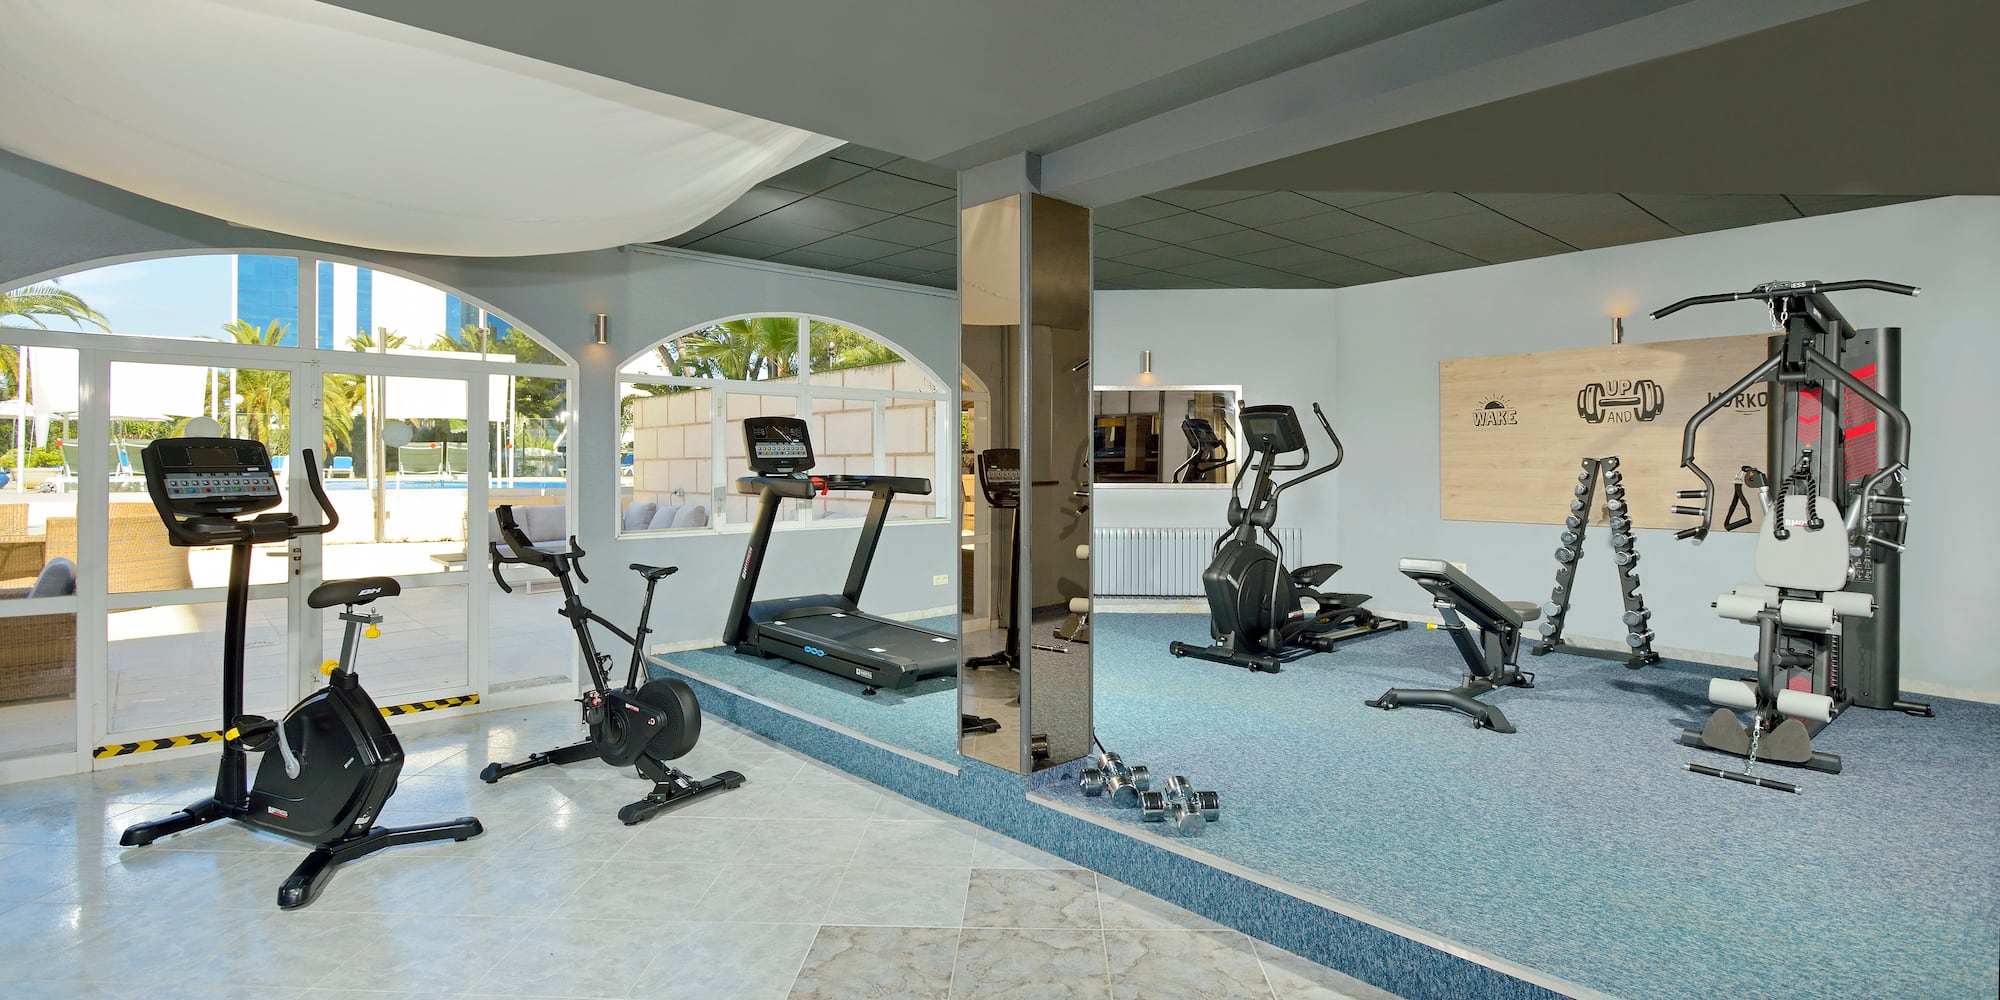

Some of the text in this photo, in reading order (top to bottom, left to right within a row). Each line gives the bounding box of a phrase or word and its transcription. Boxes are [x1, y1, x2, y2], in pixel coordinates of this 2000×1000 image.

[1605, 380, 1632, 397] UP
[1473, 409, 1518, 427] WAKE
[1607, 410, 1632, 423] AND
